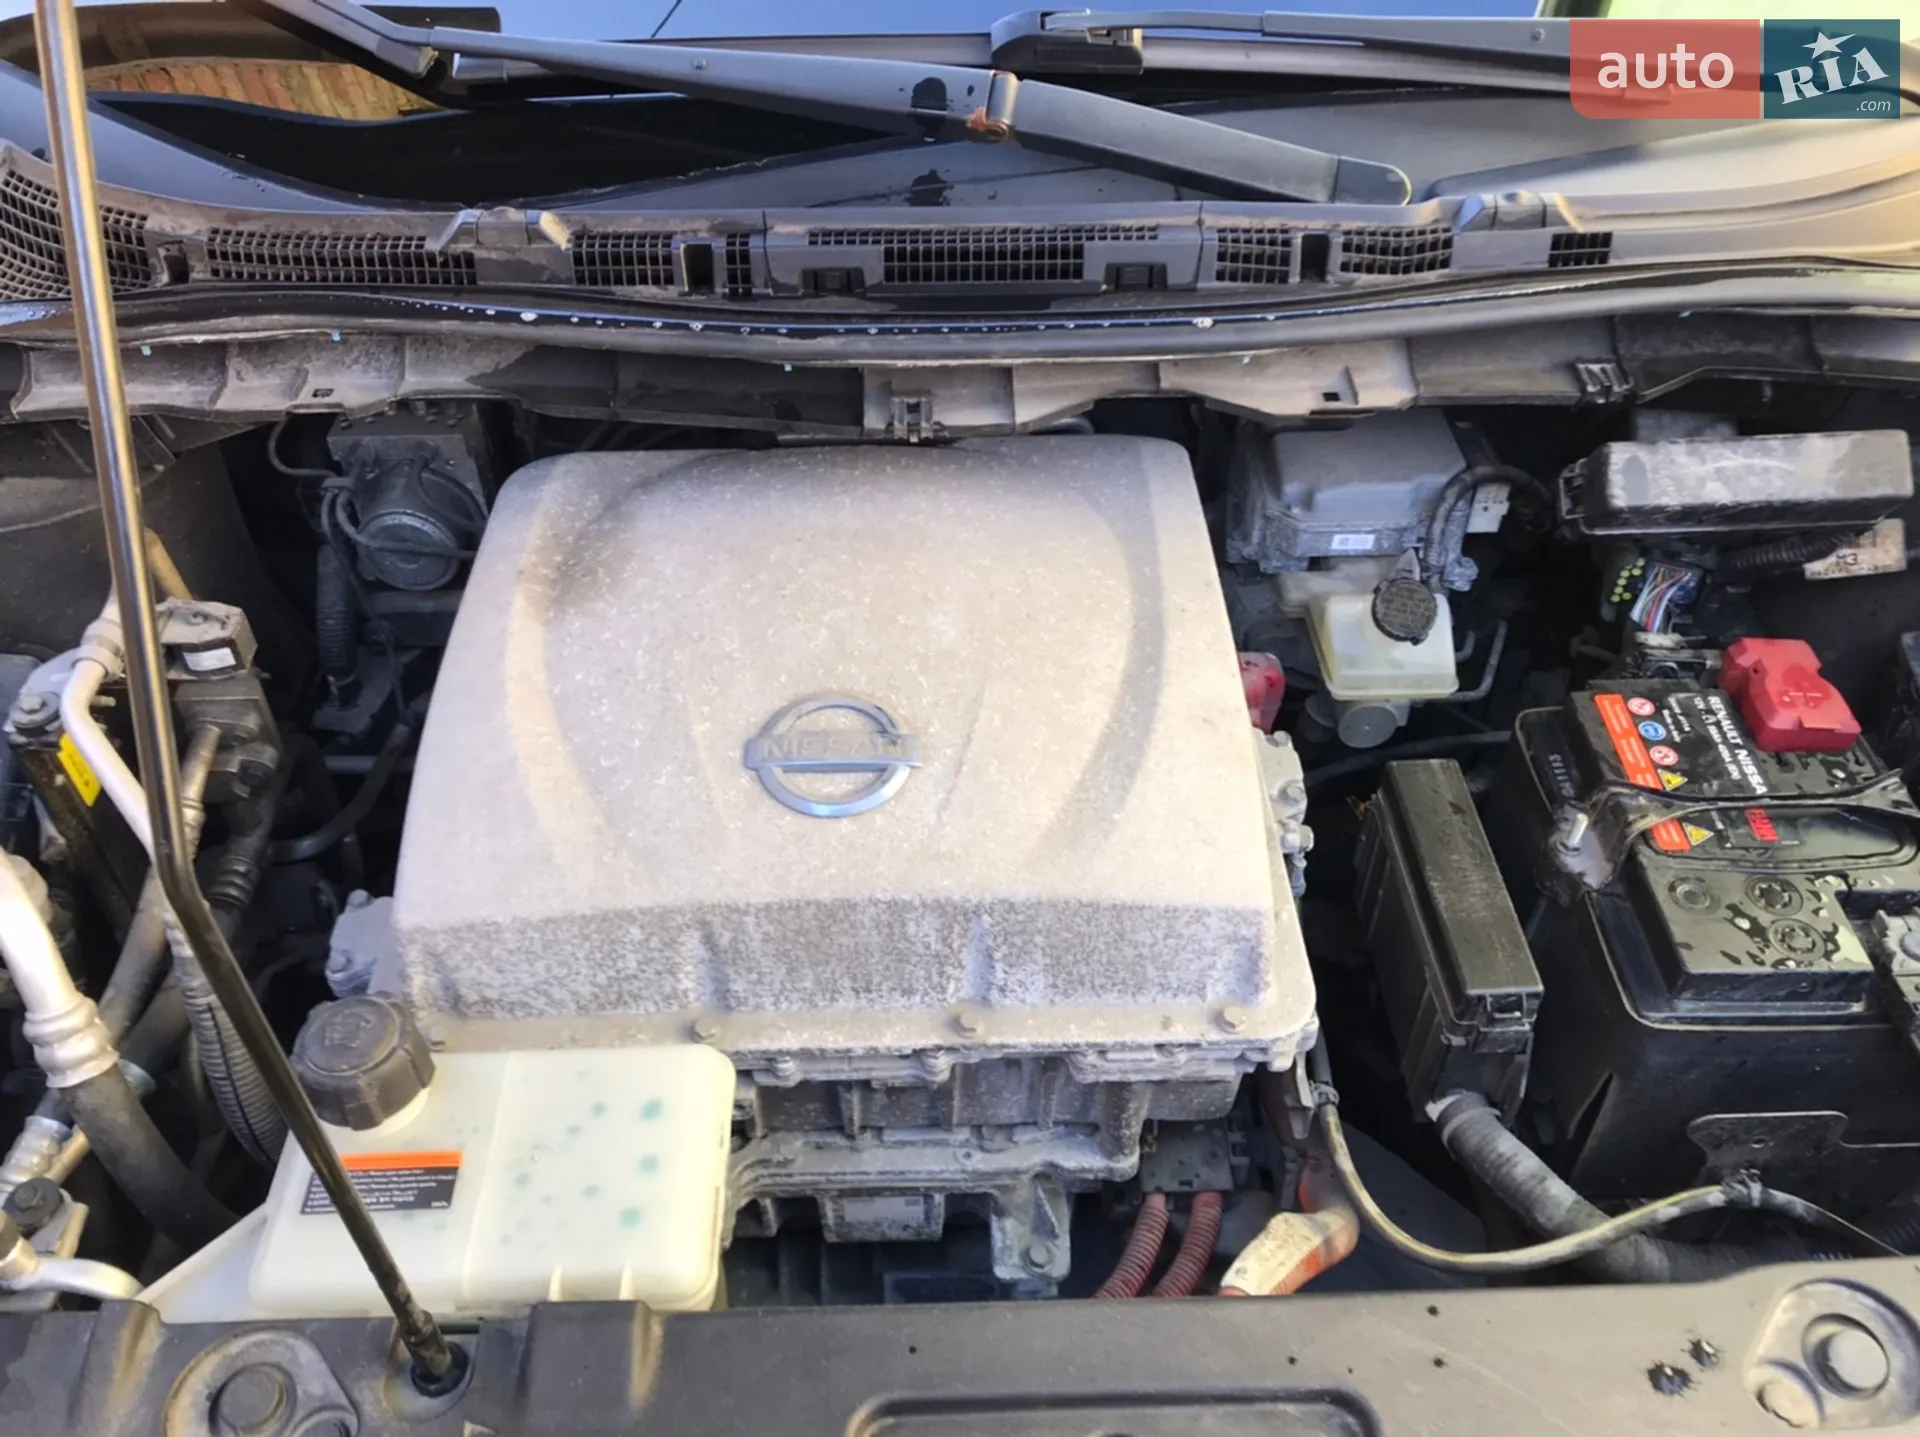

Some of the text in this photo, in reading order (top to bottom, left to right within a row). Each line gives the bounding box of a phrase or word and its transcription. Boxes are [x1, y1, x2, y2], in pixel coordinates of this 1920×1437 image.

[763, 737, 904, 760] NISSAN
[1707, 695, 1768, 795] RENAULT NISSA
